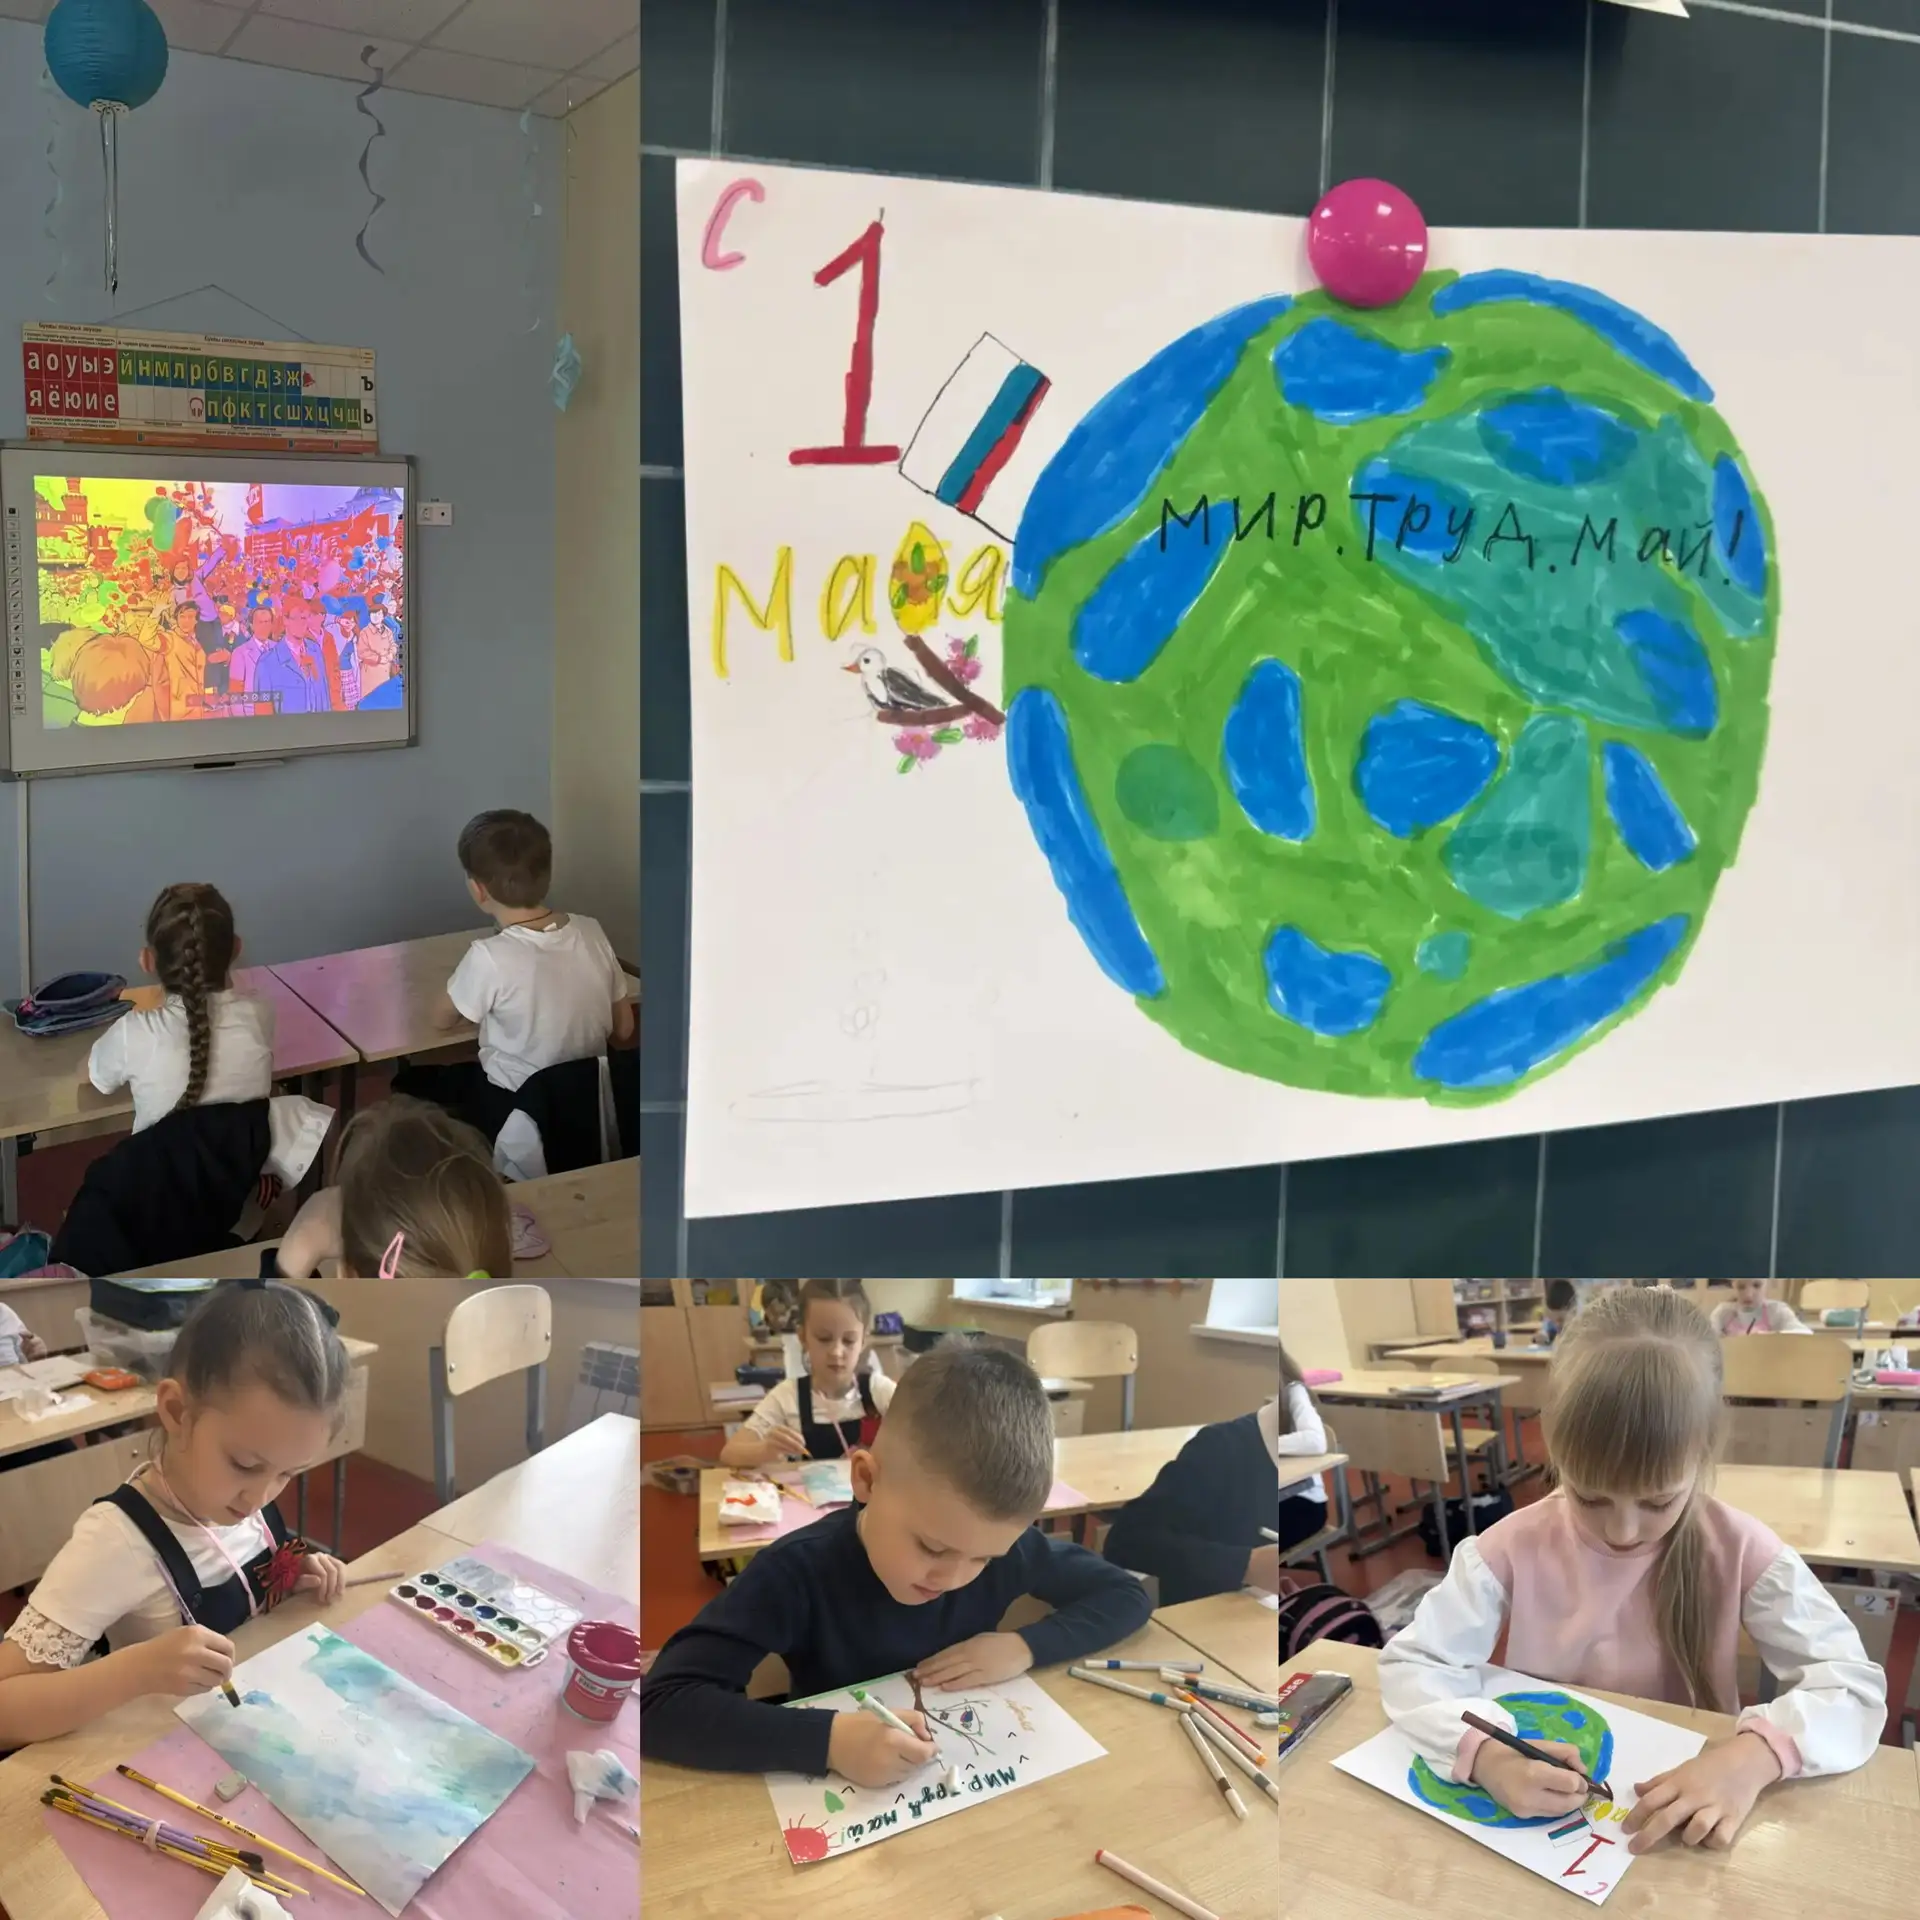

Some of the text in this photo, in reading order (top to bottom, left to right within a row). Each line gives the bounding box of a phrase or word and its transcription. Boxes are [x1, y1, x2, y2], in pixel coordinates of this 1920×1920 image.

[788, 218, 900, 465] 1
[1864, 1595, 1876, 1612] 2
[1561, 1832, 1616, 1877] 1
